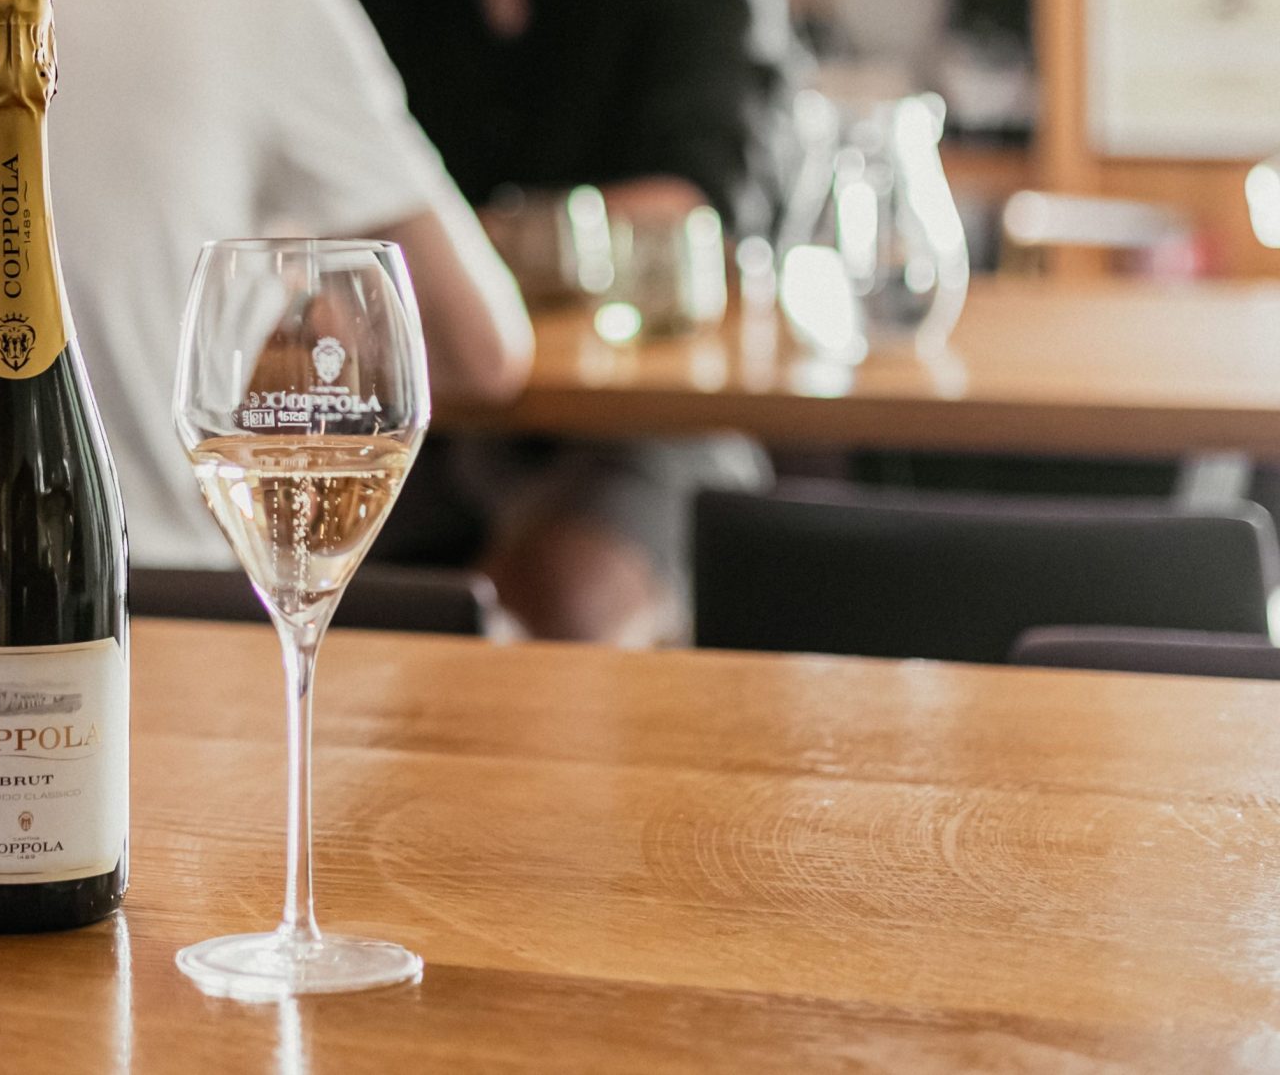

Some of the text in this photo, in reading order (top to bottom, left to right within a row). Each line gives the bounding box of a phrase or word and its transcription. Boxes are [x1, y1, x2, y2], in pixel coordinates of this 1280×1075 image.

[1, 153, 22, 299] COPPOLA
[23, 208, 31, 244] 1489
[23, 789, 82, 801] CLASSICO
